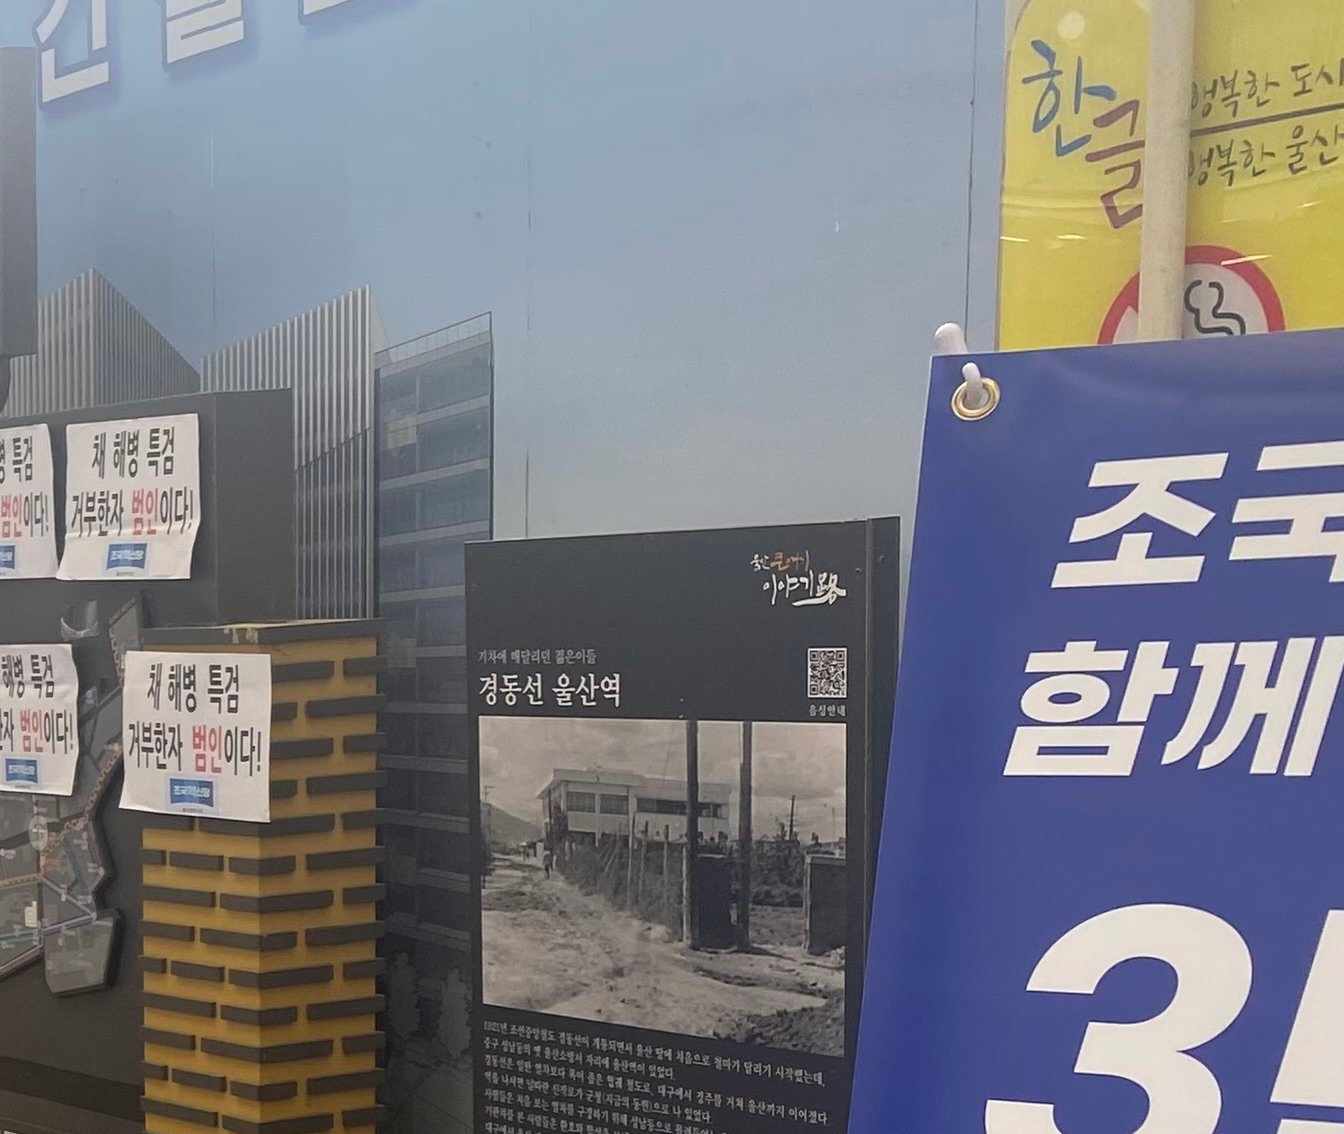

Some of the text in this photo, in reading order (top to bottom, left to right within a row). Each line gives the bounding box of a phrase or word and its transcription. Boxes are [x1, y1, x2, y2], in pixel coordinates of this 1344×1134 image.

[1022, 39, 1145, 229] 한글
[12, 436, 33, 482] 특검
[92, 426, 175, 479] 채 해병 특검
[1, 492, 49, 538] 범인이다!
[71, 486, 194, 537] 거부한자 범인이다!
[1, 654, 25, 698] 해병
[30, 654, 55, 699] 특검
[478, 649, 597, 664] 기차에 매달리던 젊은이들
[147, 663, 239, 714] 채 해병 특검
[479, 672, 621, 708] 경동선 울산역
[1002, 636, 1344, 777] 함께
[20, 709, 73, 754] 범인이다!
[128, 721, 261, 776] 거부한자 범인이다!
